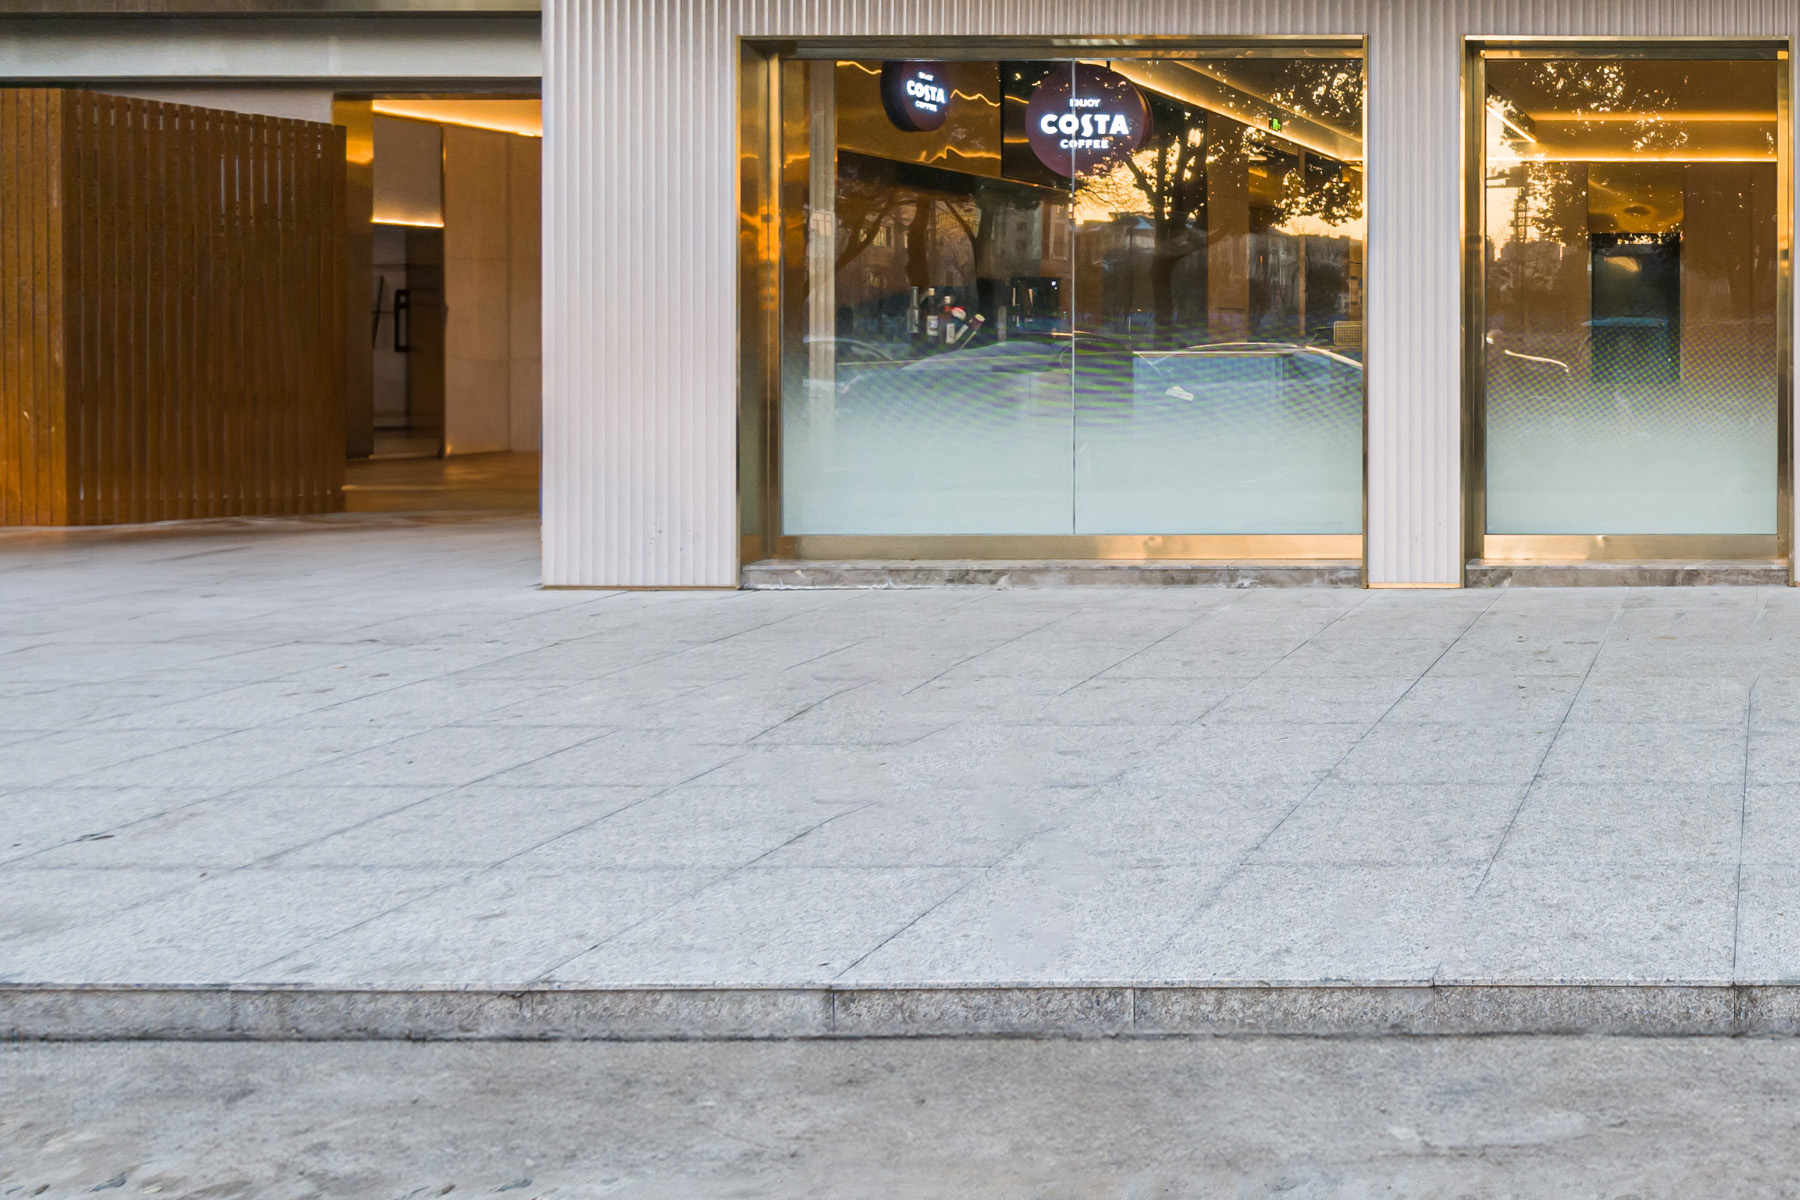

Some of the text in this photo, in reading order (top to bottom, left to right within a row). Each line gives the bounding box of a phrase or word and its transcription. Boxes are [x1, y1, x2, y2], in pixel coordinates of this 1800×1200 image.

[906, 79, 946, 104] COSTA
[1069, 98, 1101, 108] ENJOY
[1040, 113, 1130, 138] COSTA
[1060, 138, 1109, 149] COFFEE
